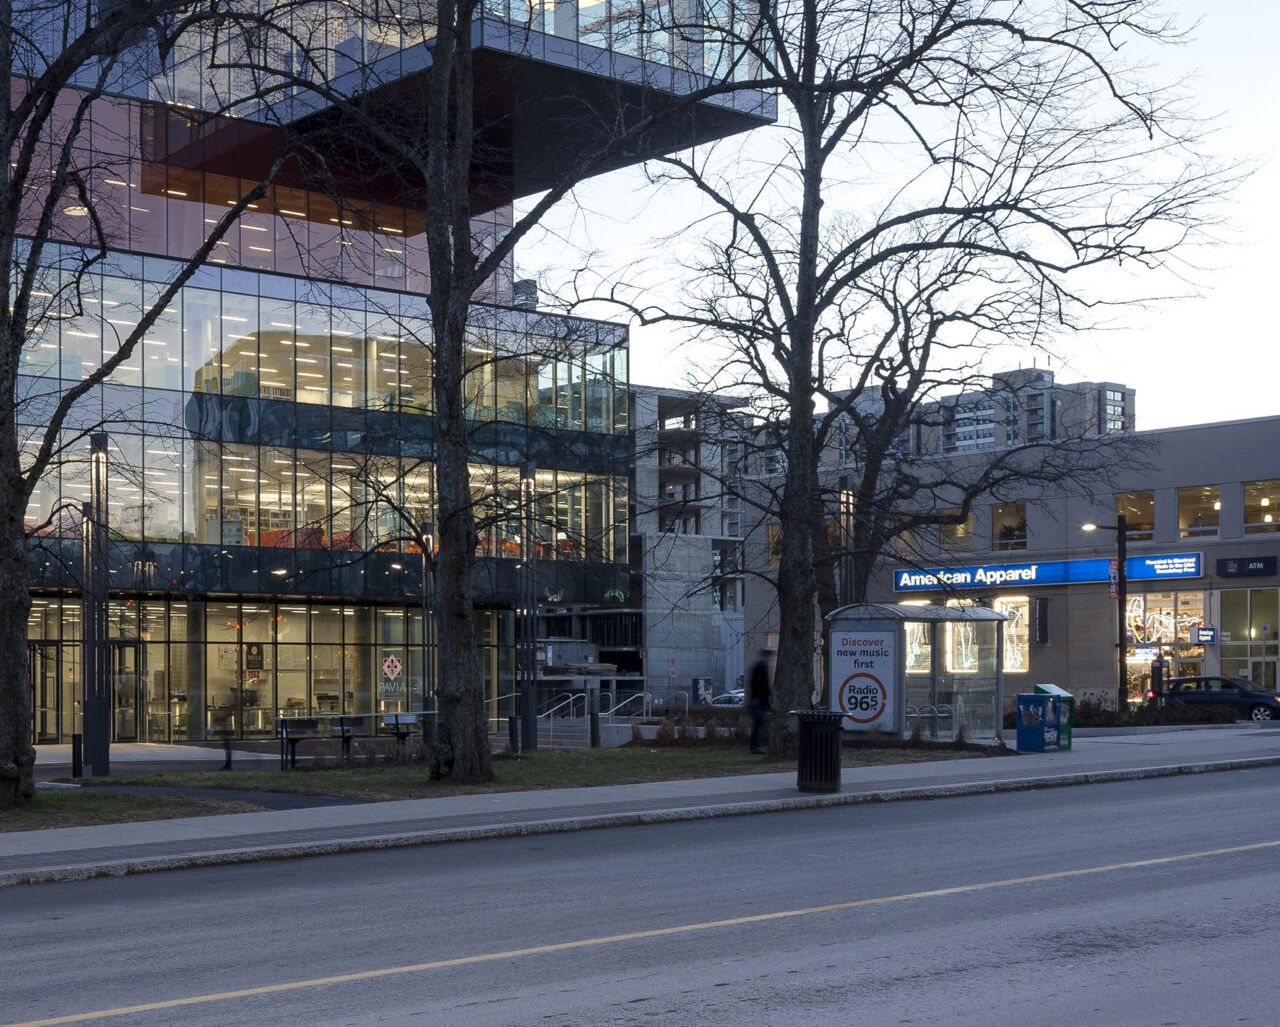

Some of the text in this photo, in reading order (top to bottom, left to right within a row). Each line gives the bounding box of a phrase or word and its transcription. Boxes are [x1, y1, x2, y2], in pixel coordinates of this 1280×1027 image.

[900, 565, 1037, 586] American Apparel
[841, 637, 885, 646] Discover
[837, 647, 889, 657] new music
[854, 659, 874, 668] first
[379, 682, 406, 692] PAVIA
[848, 685, 878, 695] Radio
